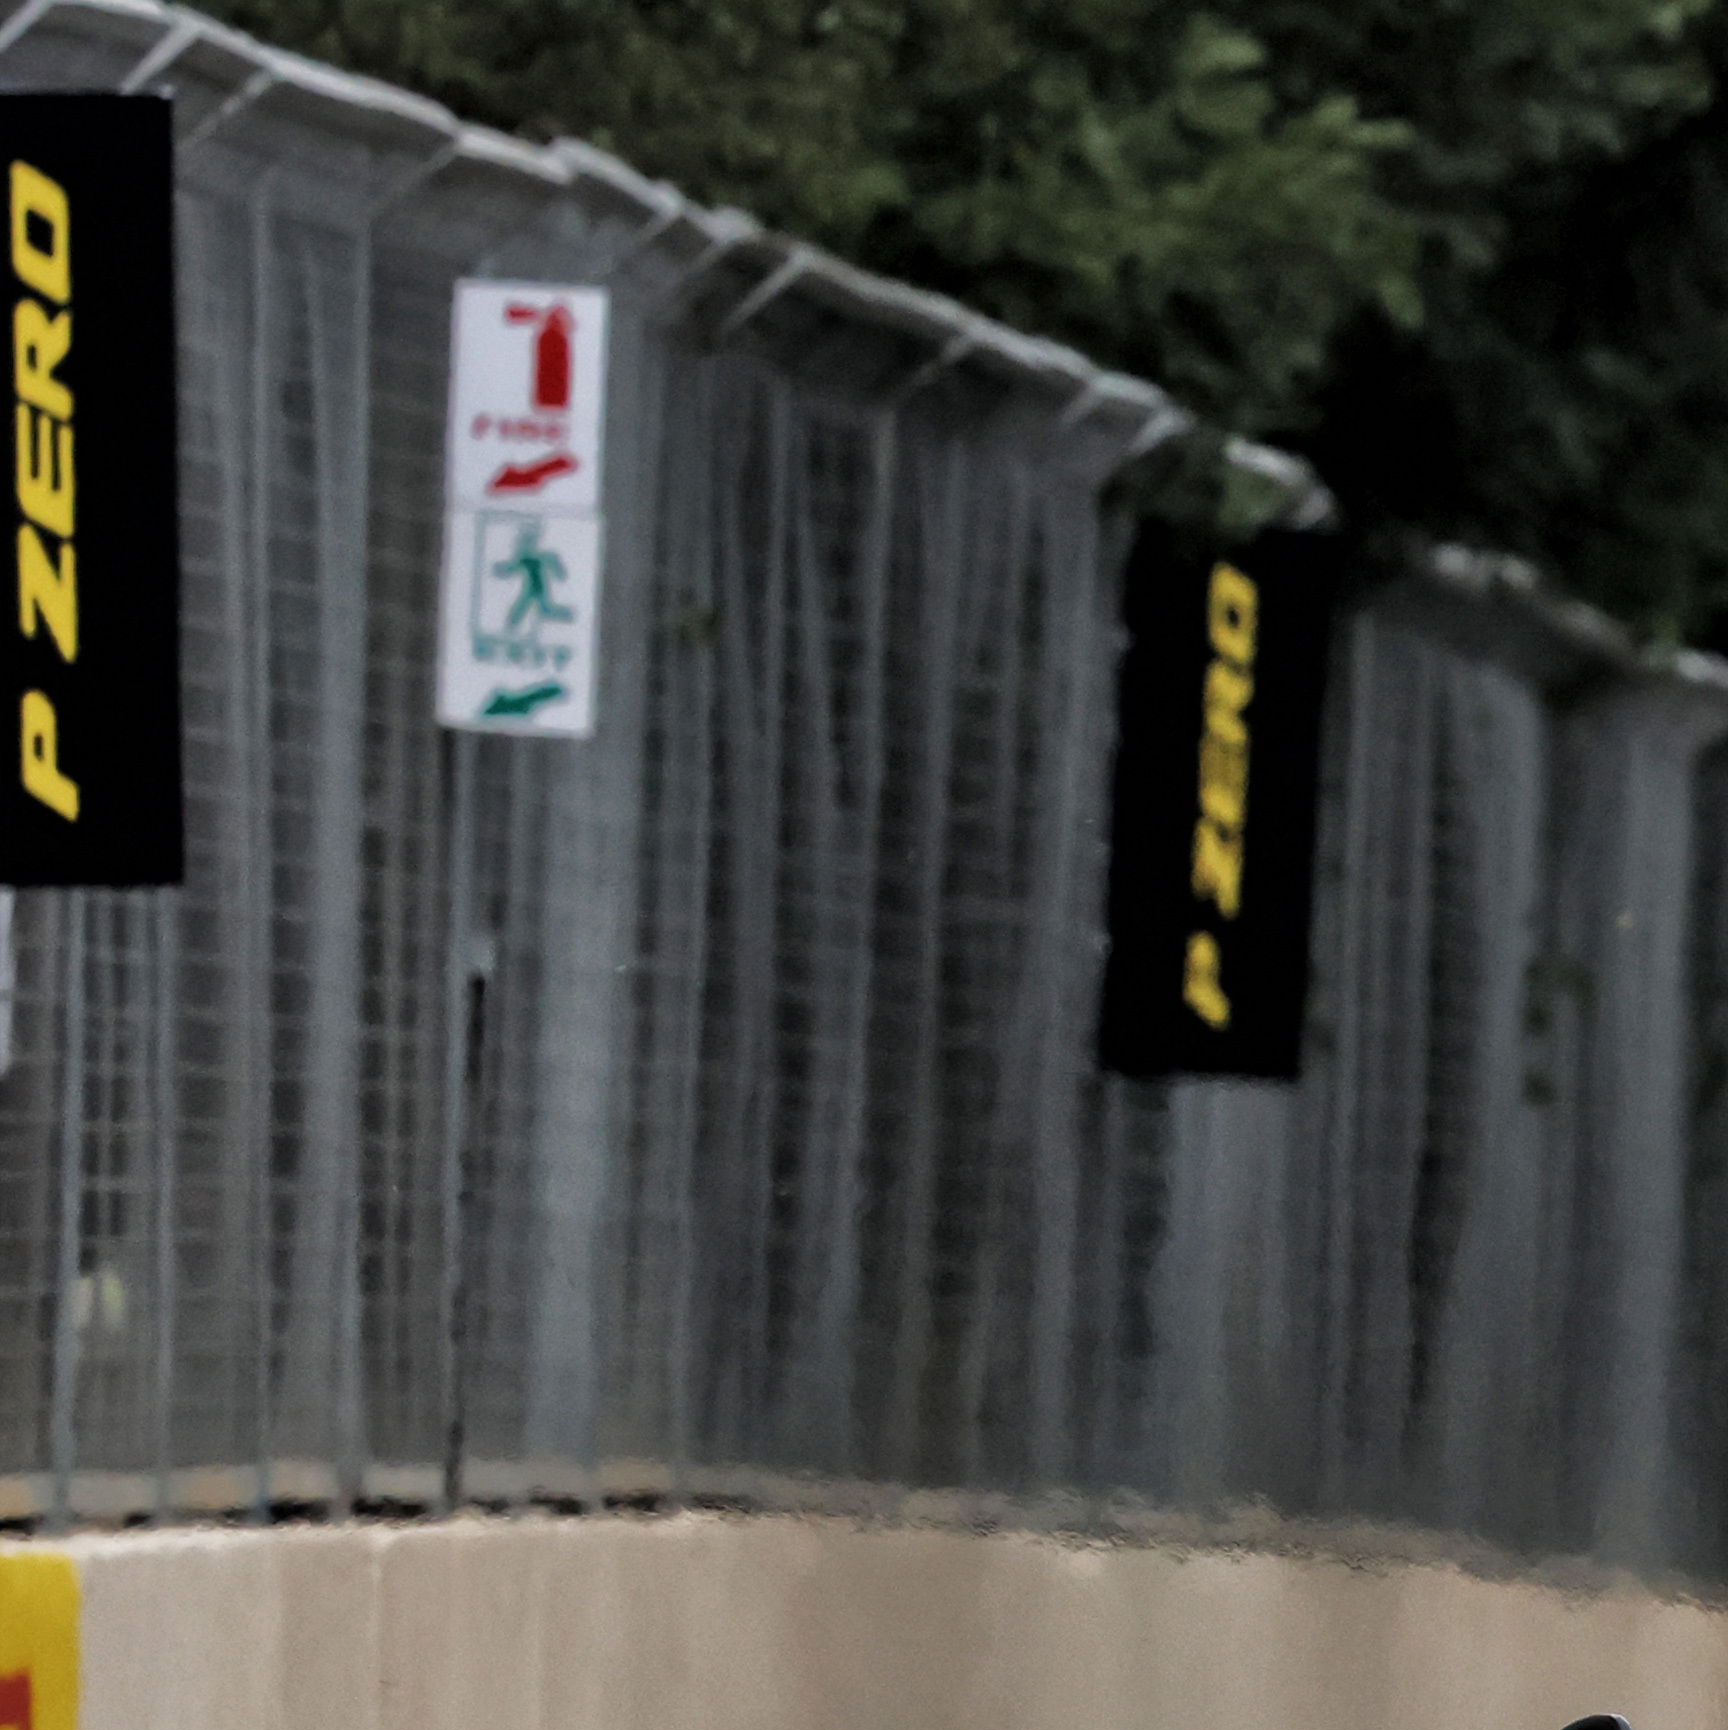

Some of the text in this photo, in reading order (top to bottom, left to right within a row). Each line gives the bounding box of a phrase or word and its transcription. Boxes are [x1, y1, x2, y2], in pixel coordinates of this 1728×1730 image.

[9, 159, 79, 823] P ZERO
[1183, 561, 1258, 1029] P ZERO
